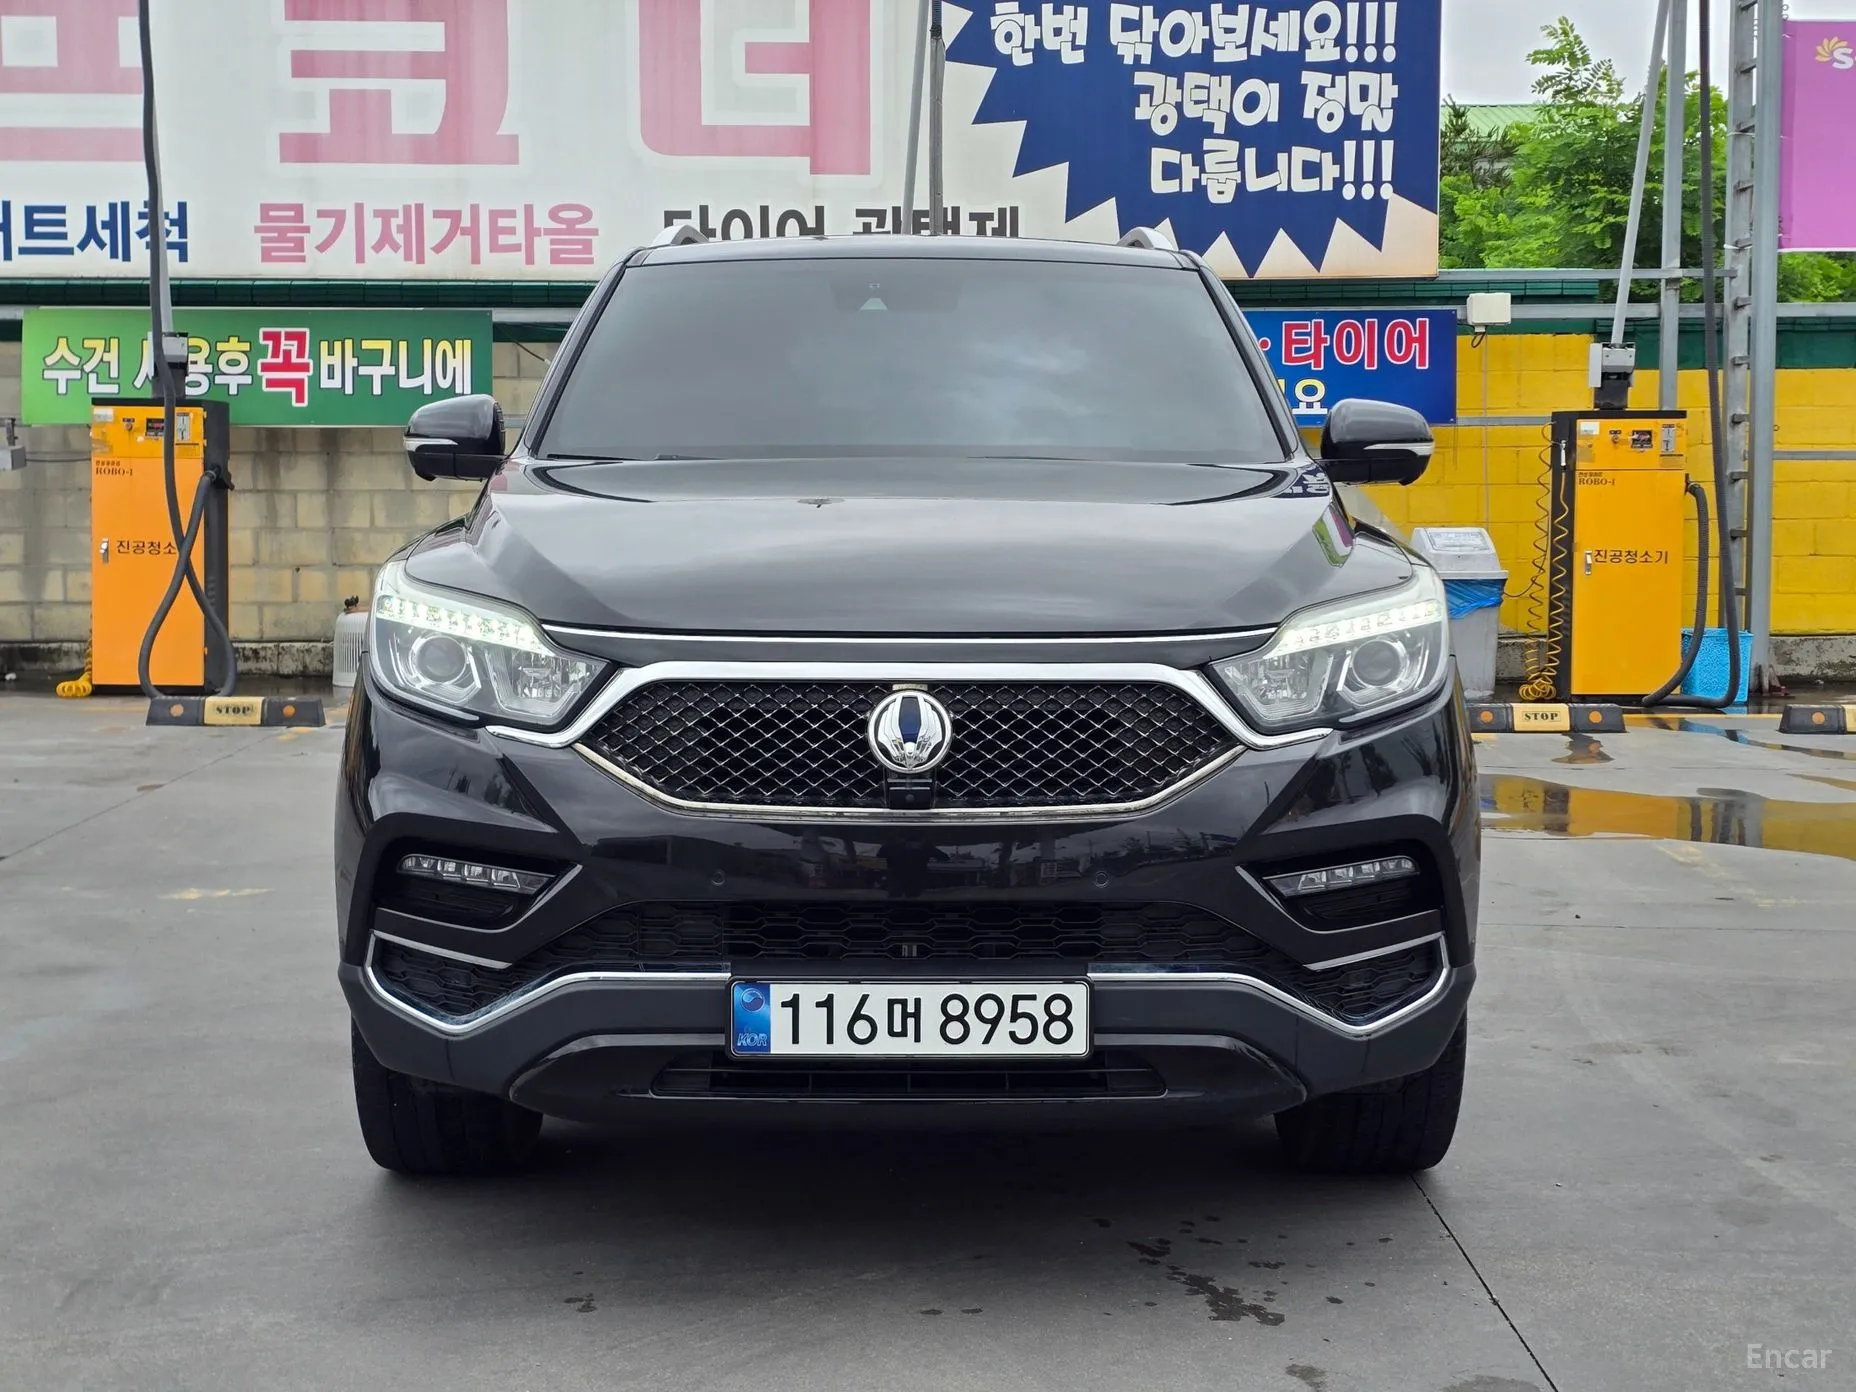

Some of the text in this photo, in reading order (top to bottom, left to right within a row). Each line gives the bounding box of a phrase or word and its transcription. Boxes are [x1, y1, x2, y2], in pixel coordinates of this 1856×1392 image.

[990, 0, 1398, 66] 한번 닦아보세요!!!
[1134, 70, 1399, 136] 광택이 정말
[254, 202, 600, 266] 물기제거타올
[42, 337, 120, 394] 수건
[258, 327, 313, 407] 꼭
[319, 337, 473, 395] 바구니에
[115, 540, 178, 556] 진공청소
[1594, 549, 1669, 565] 진공청소기
[215, 706, 251, 716] STOP
[1524, 712, 1559, 721] STOP
[939, 993, 1075, 1046] 8958
[736, 1033, 768, 1048] KOR
